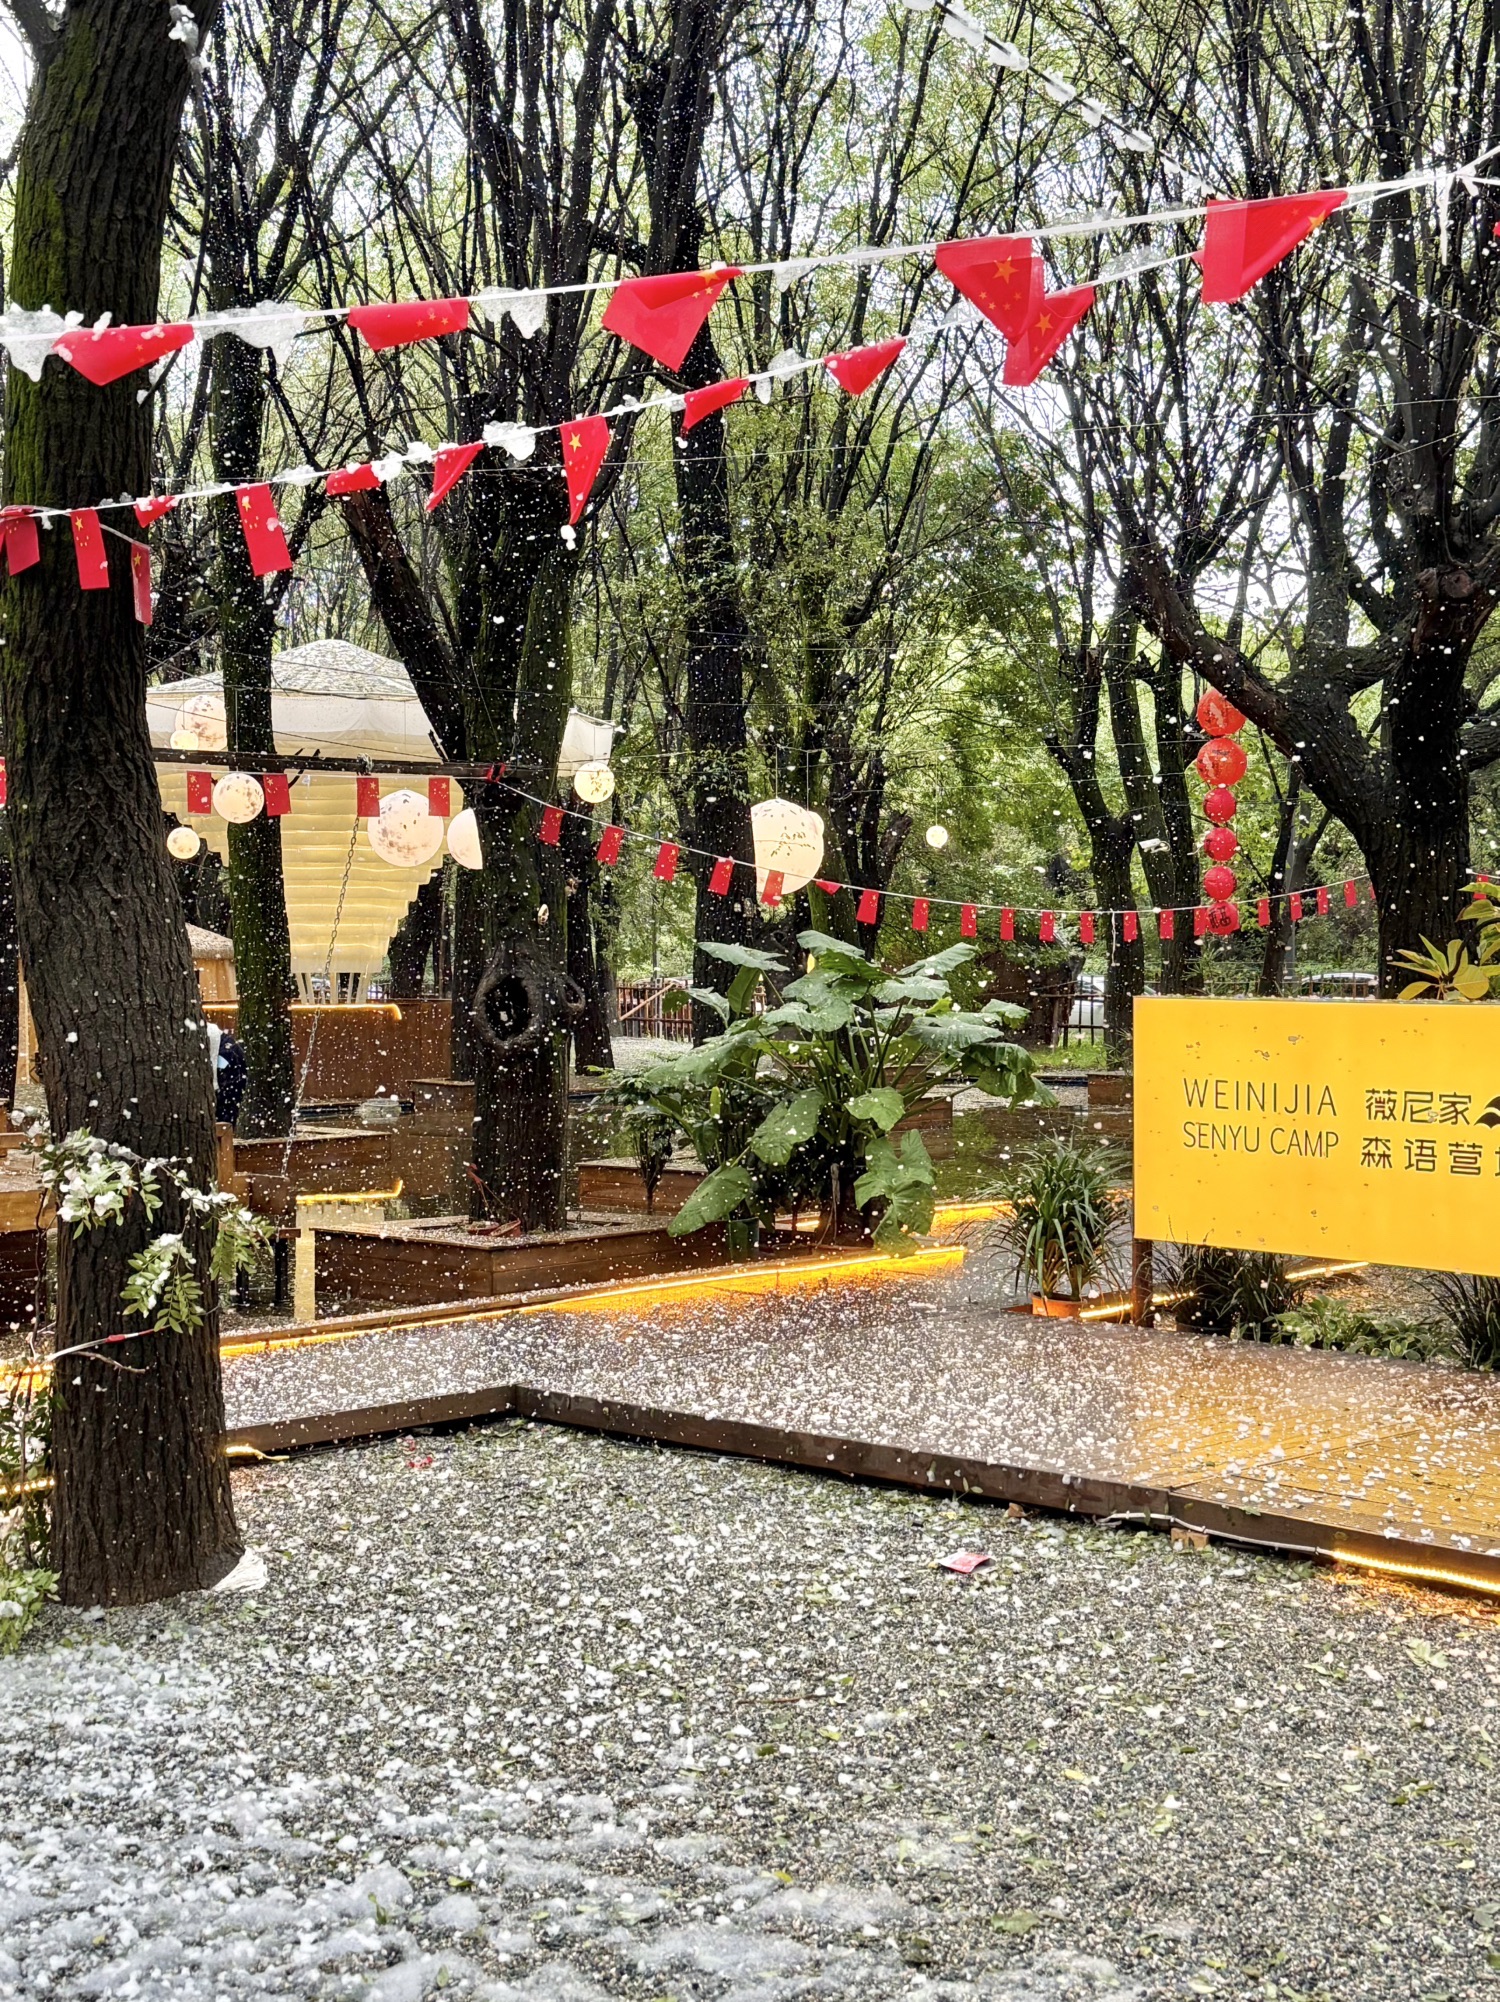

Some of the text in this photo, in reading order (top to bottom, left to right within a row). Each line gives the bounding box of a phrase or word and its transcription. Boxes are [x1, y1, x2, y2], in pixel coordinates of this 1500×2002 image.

[1183, 1077, 1338, 1117] WEINIJIA
[1365, 1087, 1472, 1126] 薇尼家
[1183, 1121, 1339, 1158] SENYU CAMP
[1360, 1136, 1500, 1177] 森语营
